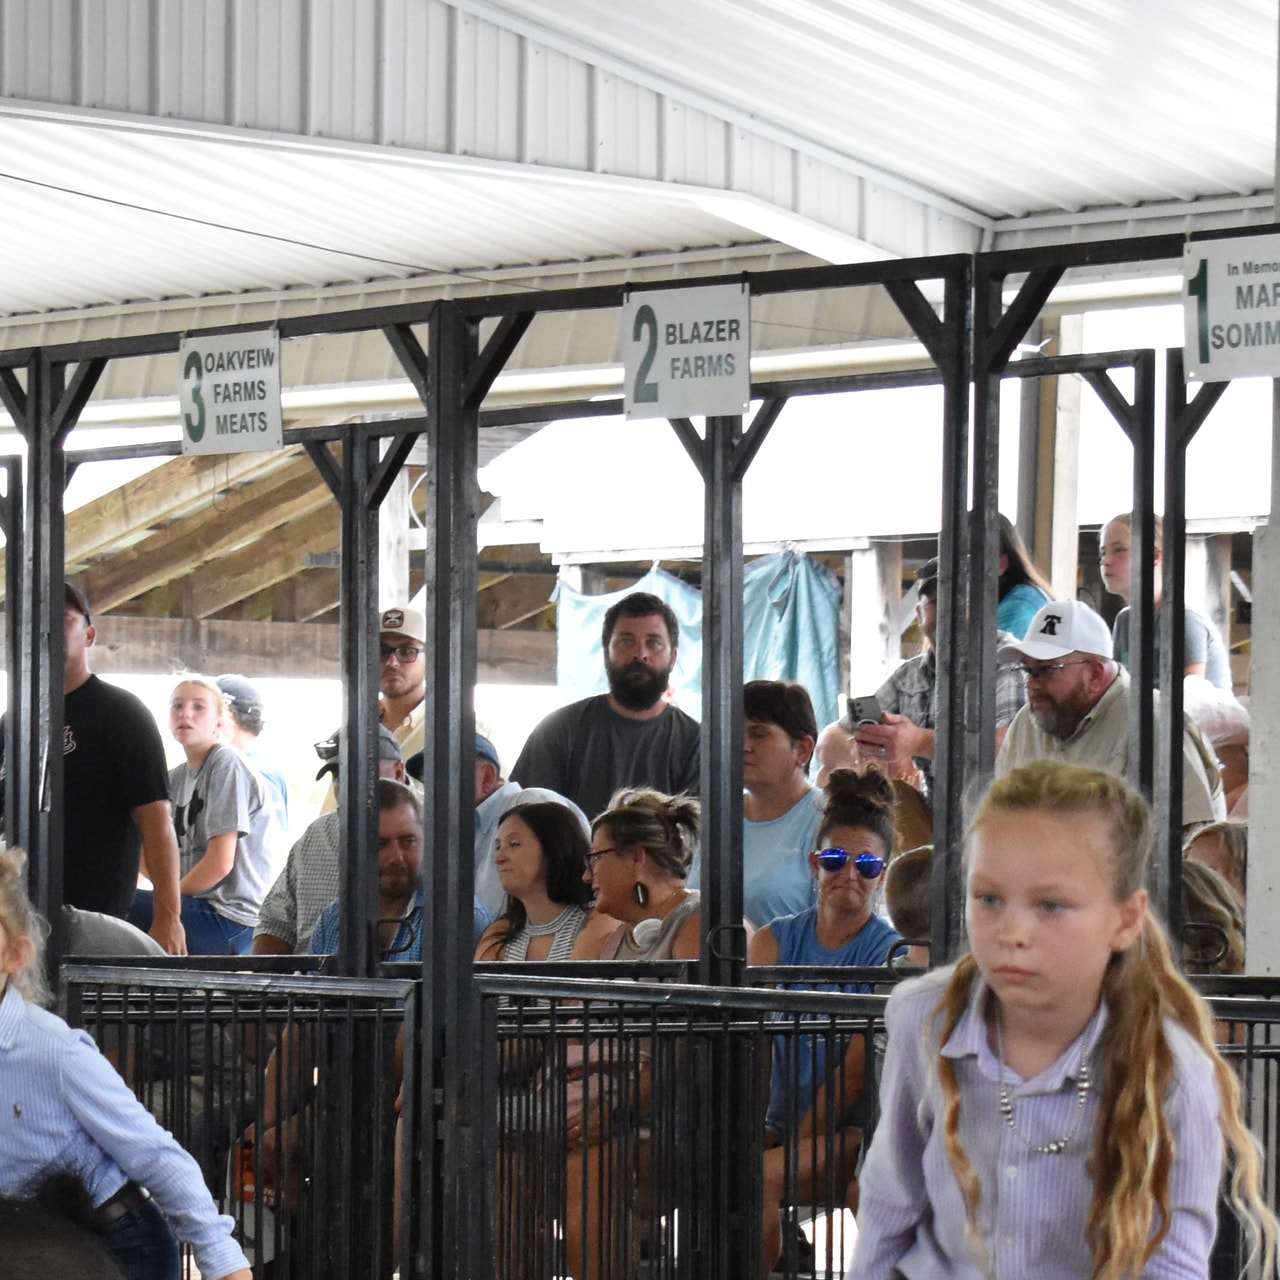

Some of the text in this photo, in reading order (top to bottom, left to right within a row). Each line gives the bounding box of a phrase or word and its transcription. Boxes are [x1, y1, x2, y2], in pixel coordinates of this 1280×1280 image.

[1227, 263, 1239, 276] In
[1188, 259, 1210, 364] 1
[665, 319, 740, 346] BLAZER
[204, 348, 274, 373] OAKVEIW
[633, 304, 658, 404] 2
[670, 353, 736, 380] FARMS
[184, 351, 206, 443] 3
[213, 380, 266, 404] FARMS
[215, 411, 268, 435] MEATS
